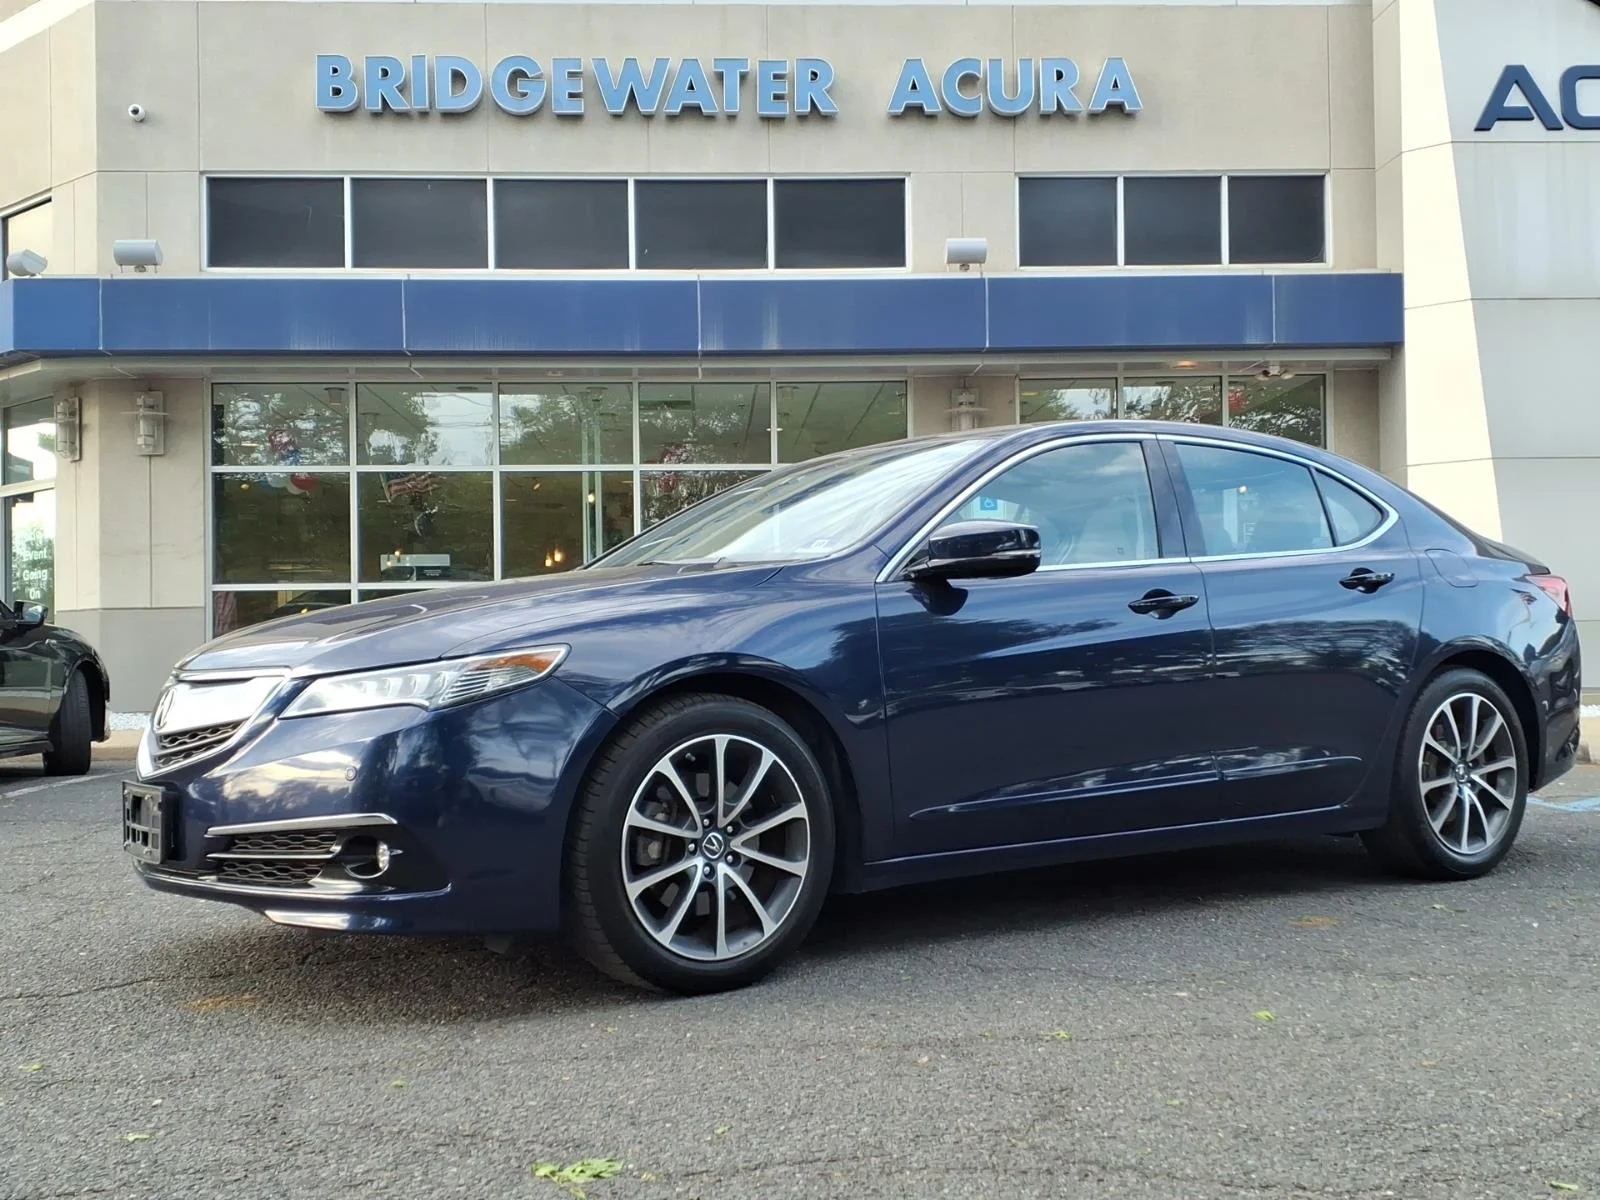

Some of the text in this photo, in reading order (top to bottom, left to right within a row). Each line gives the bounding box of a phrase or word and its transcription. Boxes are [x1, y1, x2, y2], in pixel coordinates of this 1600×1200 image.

[315, 54, 1143, 118] BRIDGEWATER ACURA
[22, 568, 48, 581] Going
